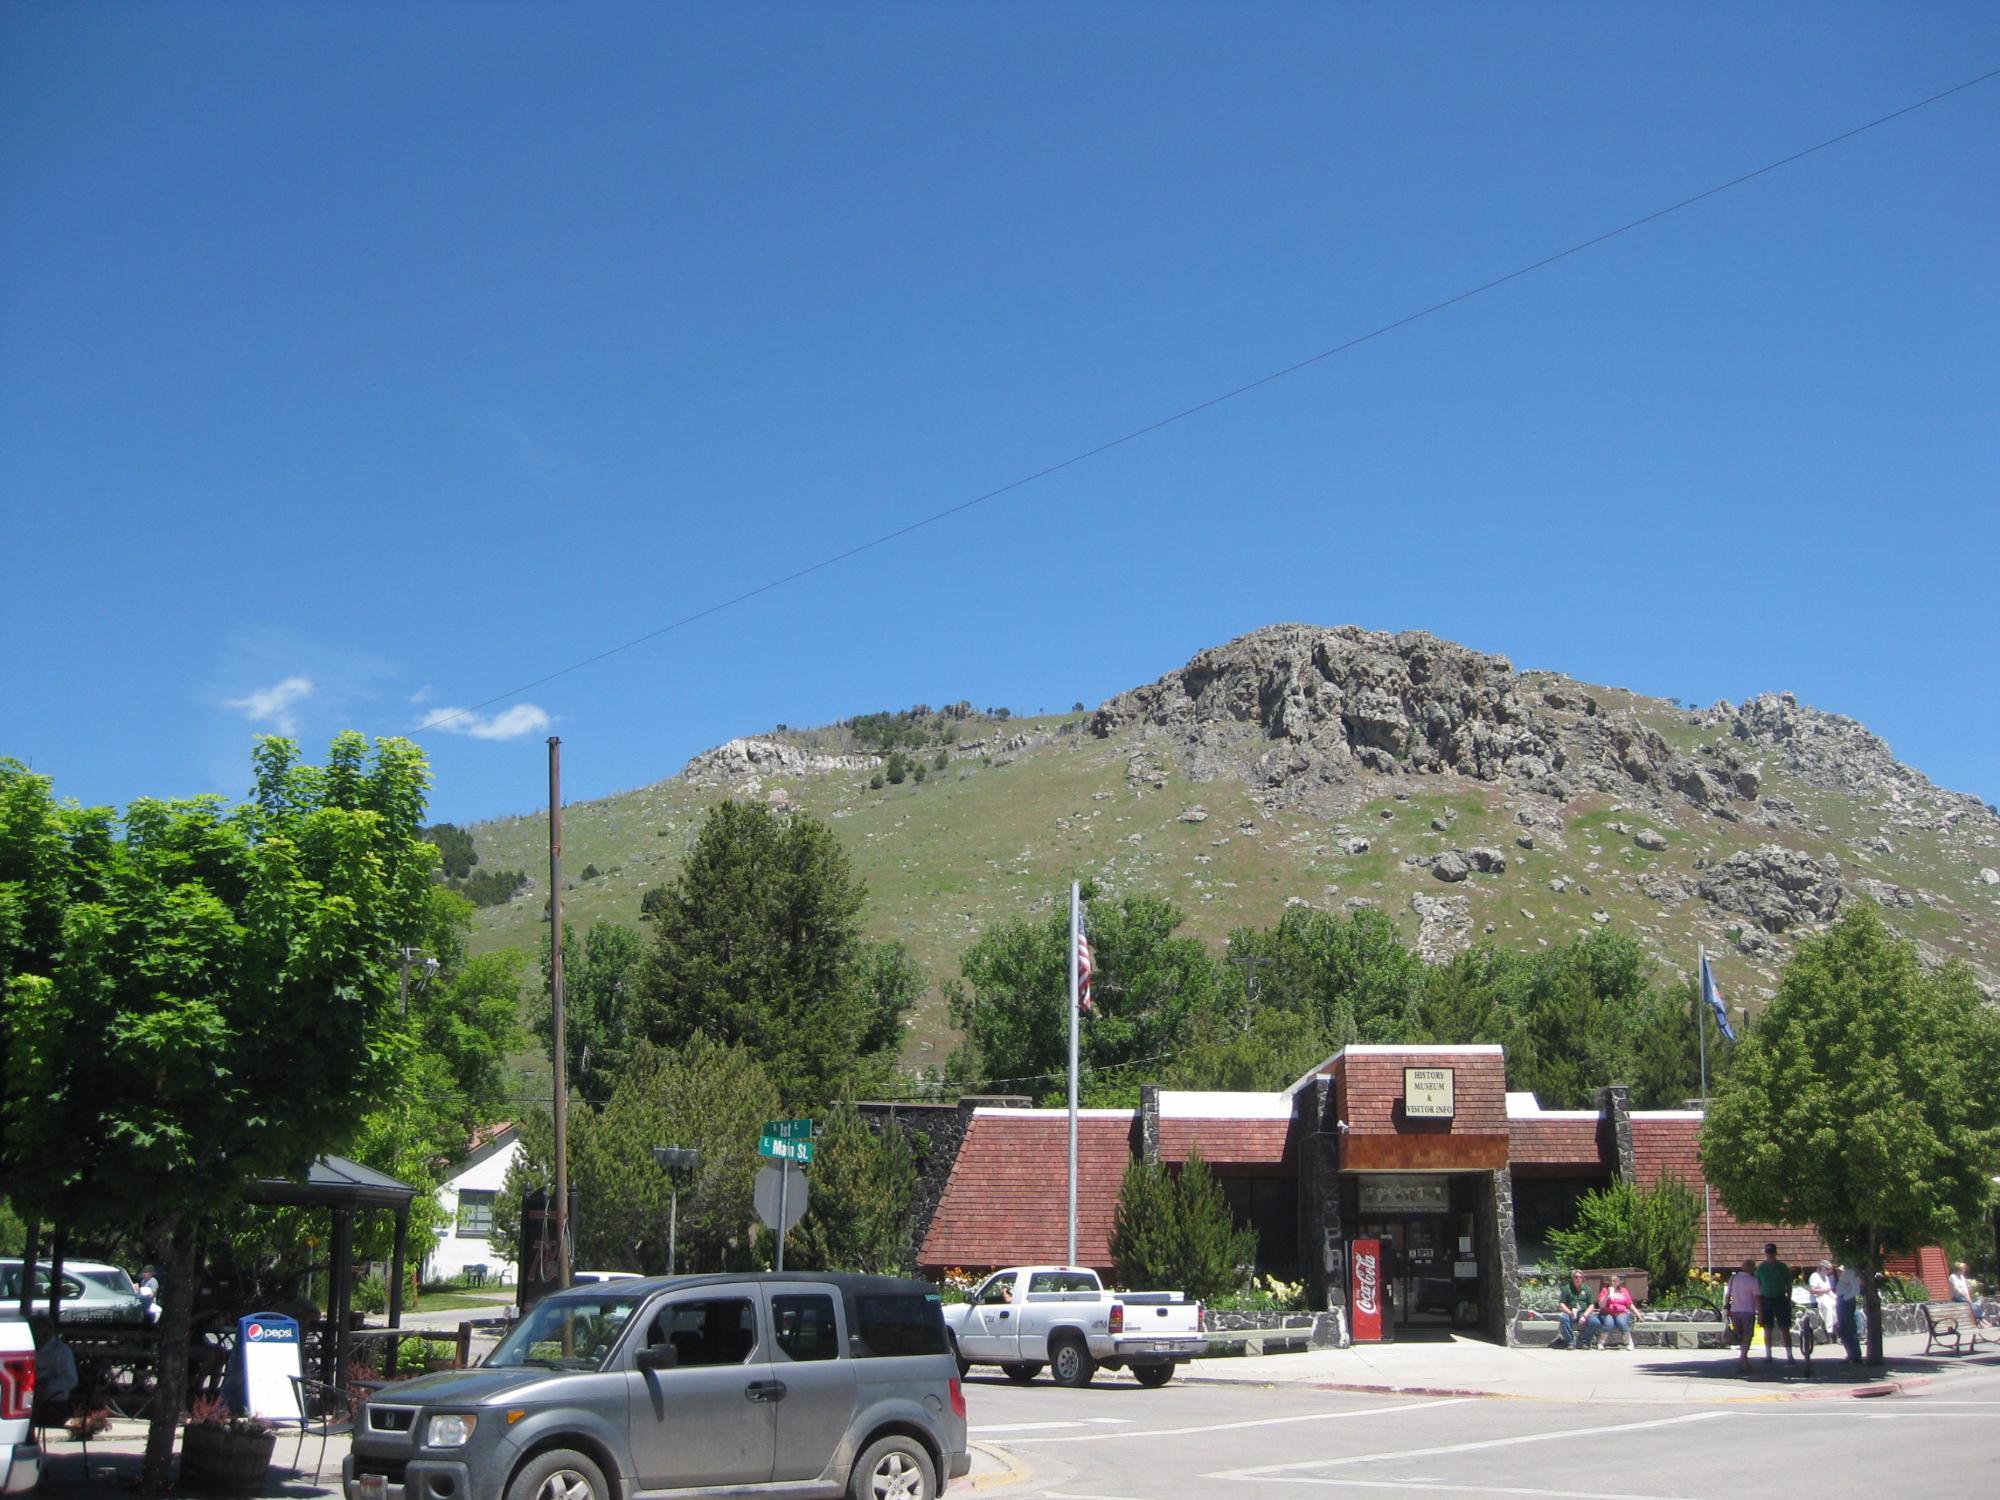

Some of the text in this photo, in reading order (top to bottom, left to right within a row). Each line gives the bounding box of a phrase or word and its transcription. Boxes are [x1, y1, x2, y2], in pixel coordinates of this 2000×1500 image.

[1414, 1071, 1444, 1079] HISTORY
[1414, 1082, 1445, 1090] MUSEUM
[1406, 1105, 1452, 1114] VISITOR INFO
[772, 1139, 794, 1157] Main
[264, 1327, 293, 1339] pepsi
